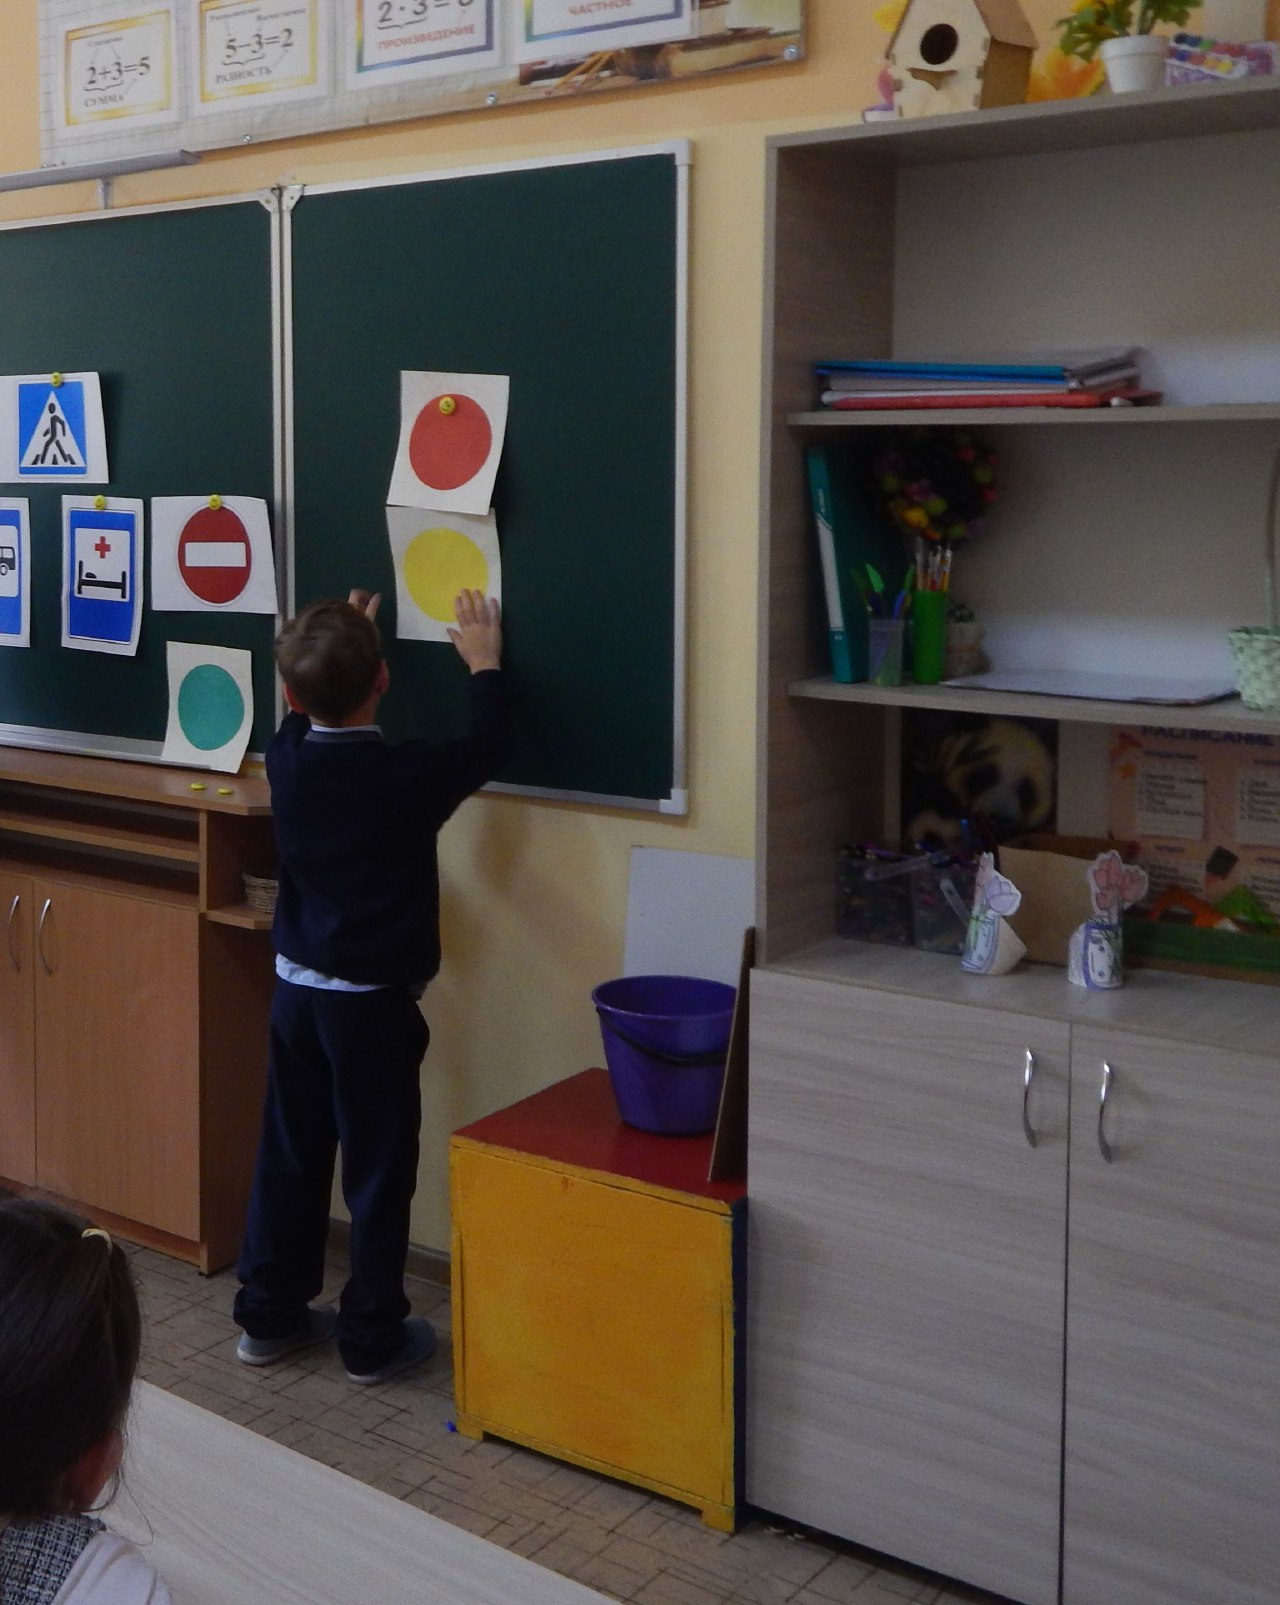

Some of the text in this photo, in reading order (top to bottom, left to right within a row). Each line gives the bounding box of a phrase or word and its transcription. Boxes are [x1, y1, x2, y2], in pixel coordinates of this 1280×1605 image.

[377, 24, 476, 49] ПРОИЗВЕДЕНИЕ
[86, 55, 151, 85] 2+3=5
[215, 66, 273, 84] РАЗНОСТЬ
[83, 94, 125, 108] СУММА
